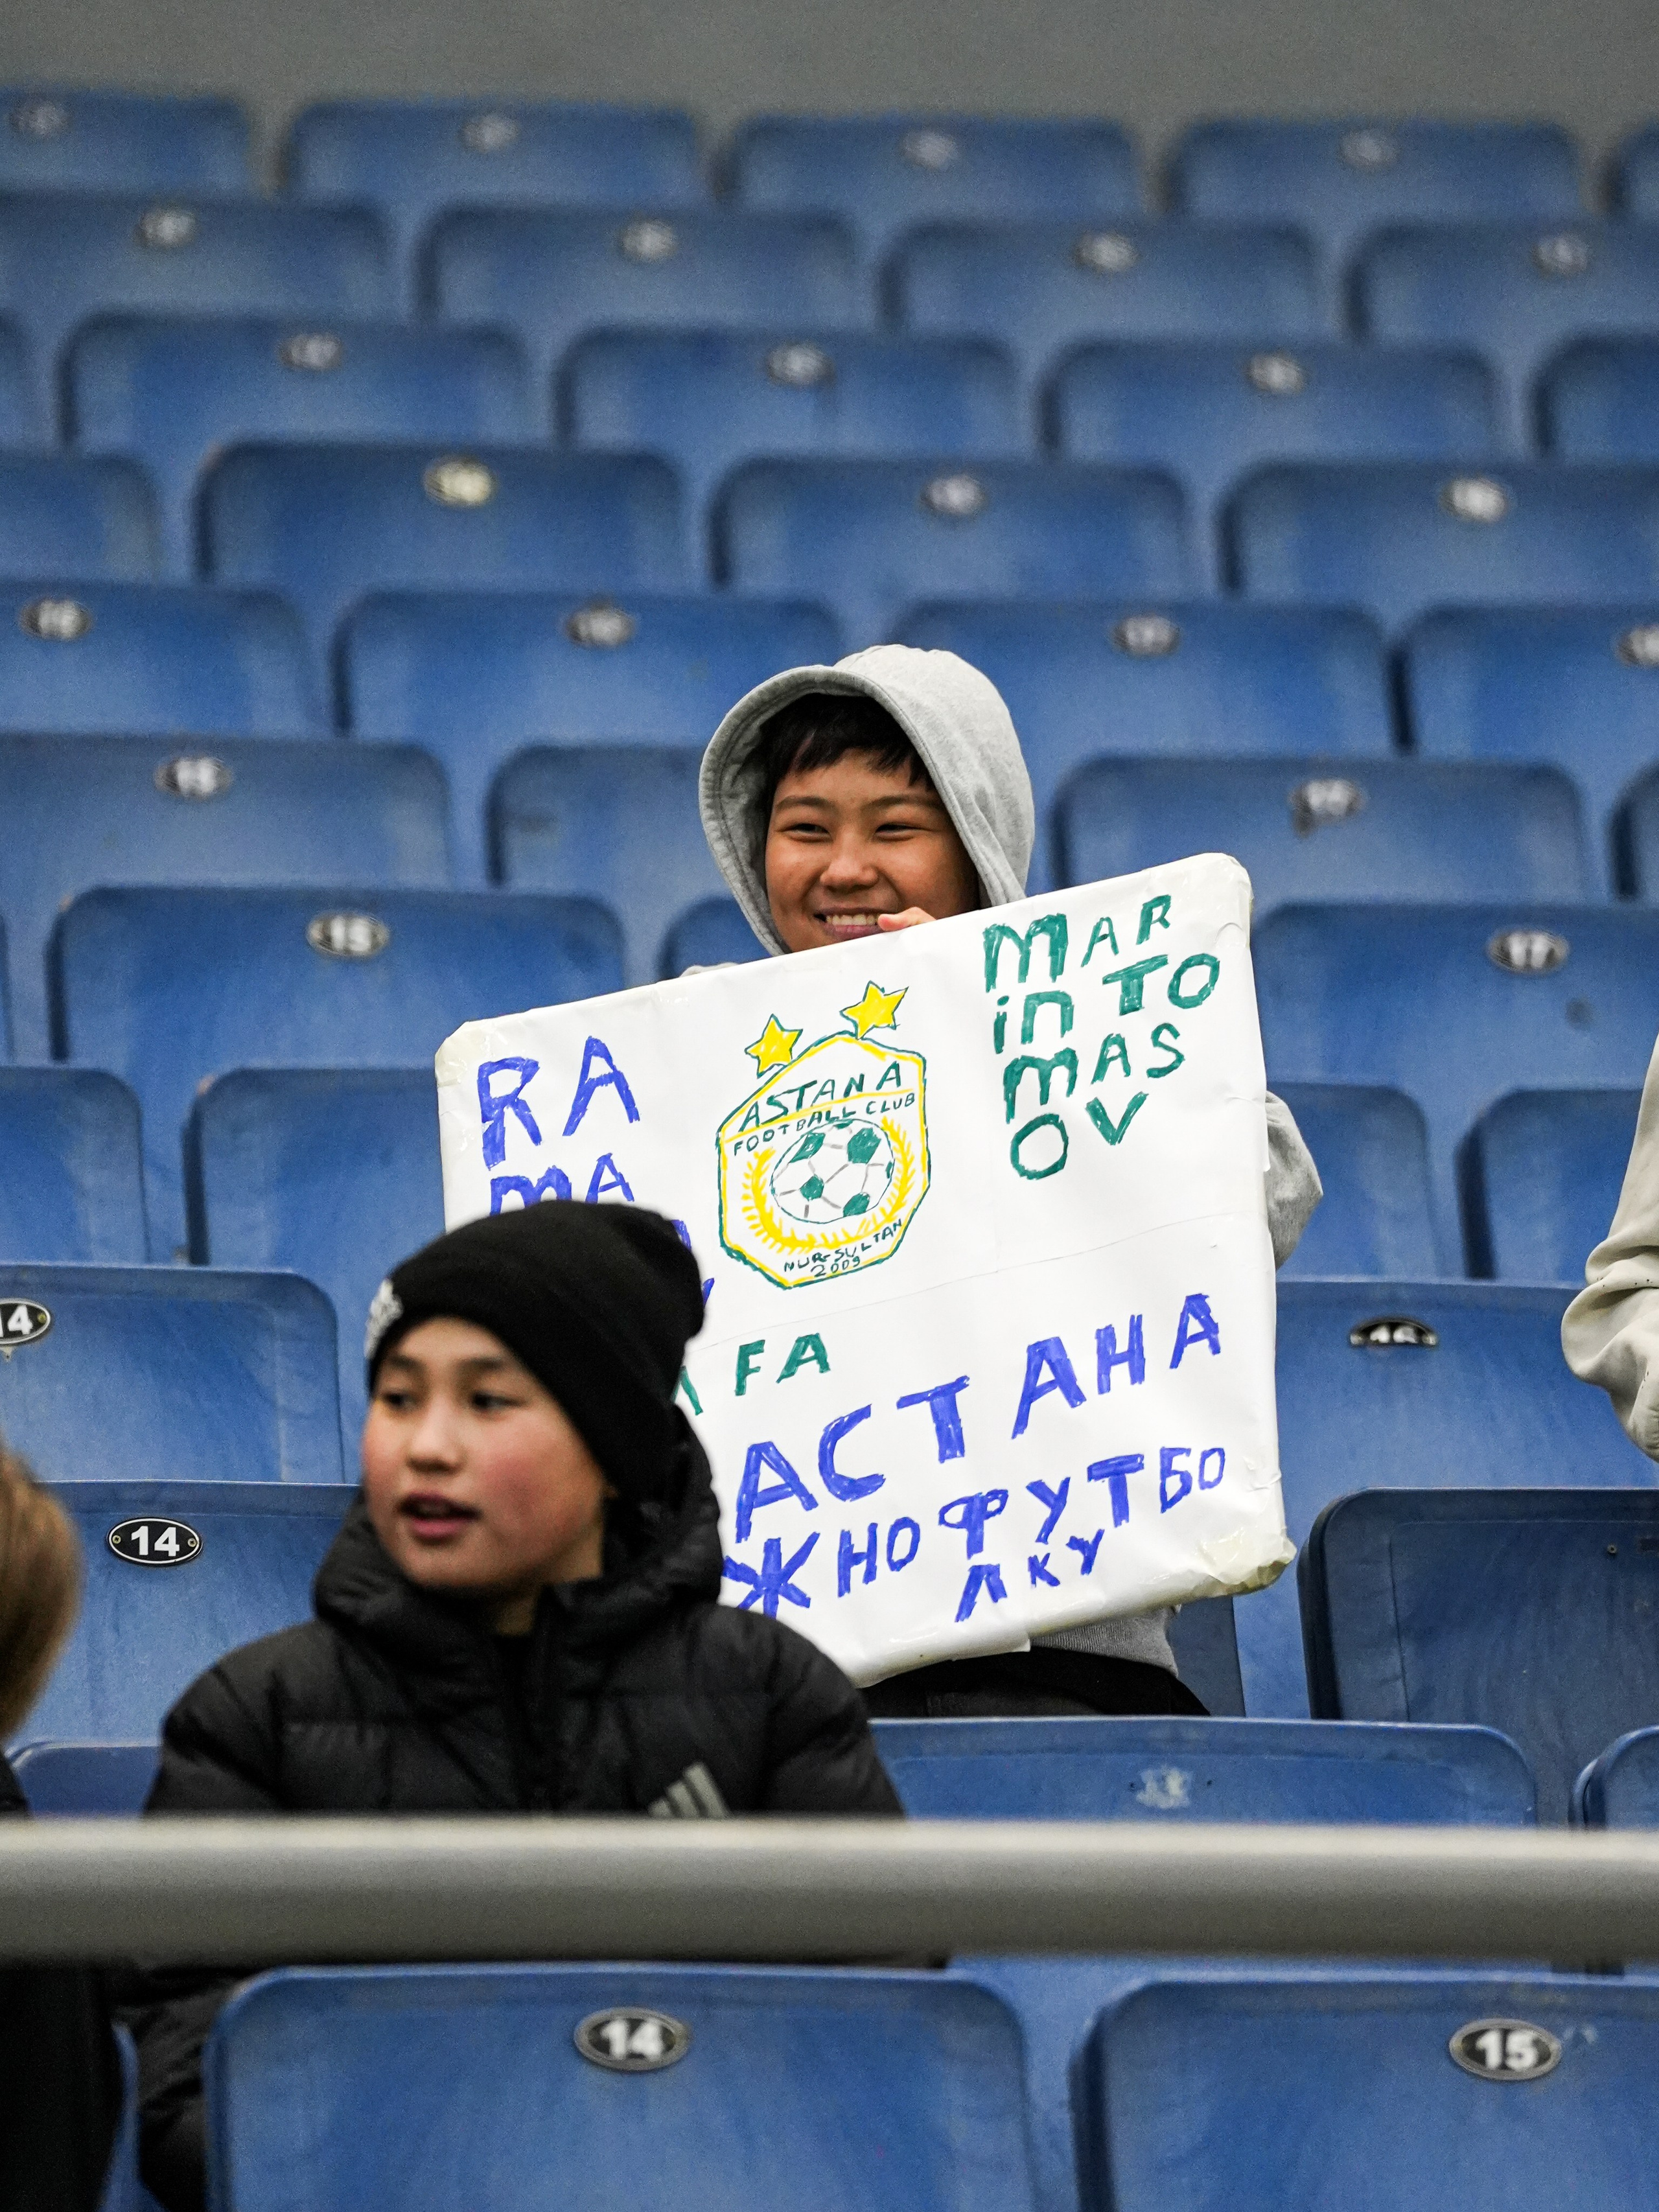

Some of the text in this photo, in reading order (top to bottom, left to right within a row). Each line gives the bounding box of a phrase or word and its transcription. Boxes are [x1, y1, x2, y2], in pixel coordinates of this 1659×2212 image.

[737, 1060, 901, 1133] ASTANA
[733, 1092, 915, 1156] FOOTBALL CLUB
[1009, 1091, 1150, 1181] OV
[810, 1255, 861, 1277] 2009
[0, 1304, 34, 1338] 4
[131, 1526, 180, 1557] 14
[600, 2018, 664, 2062] 14
[1475, 2029, 1538, 2071] 15
